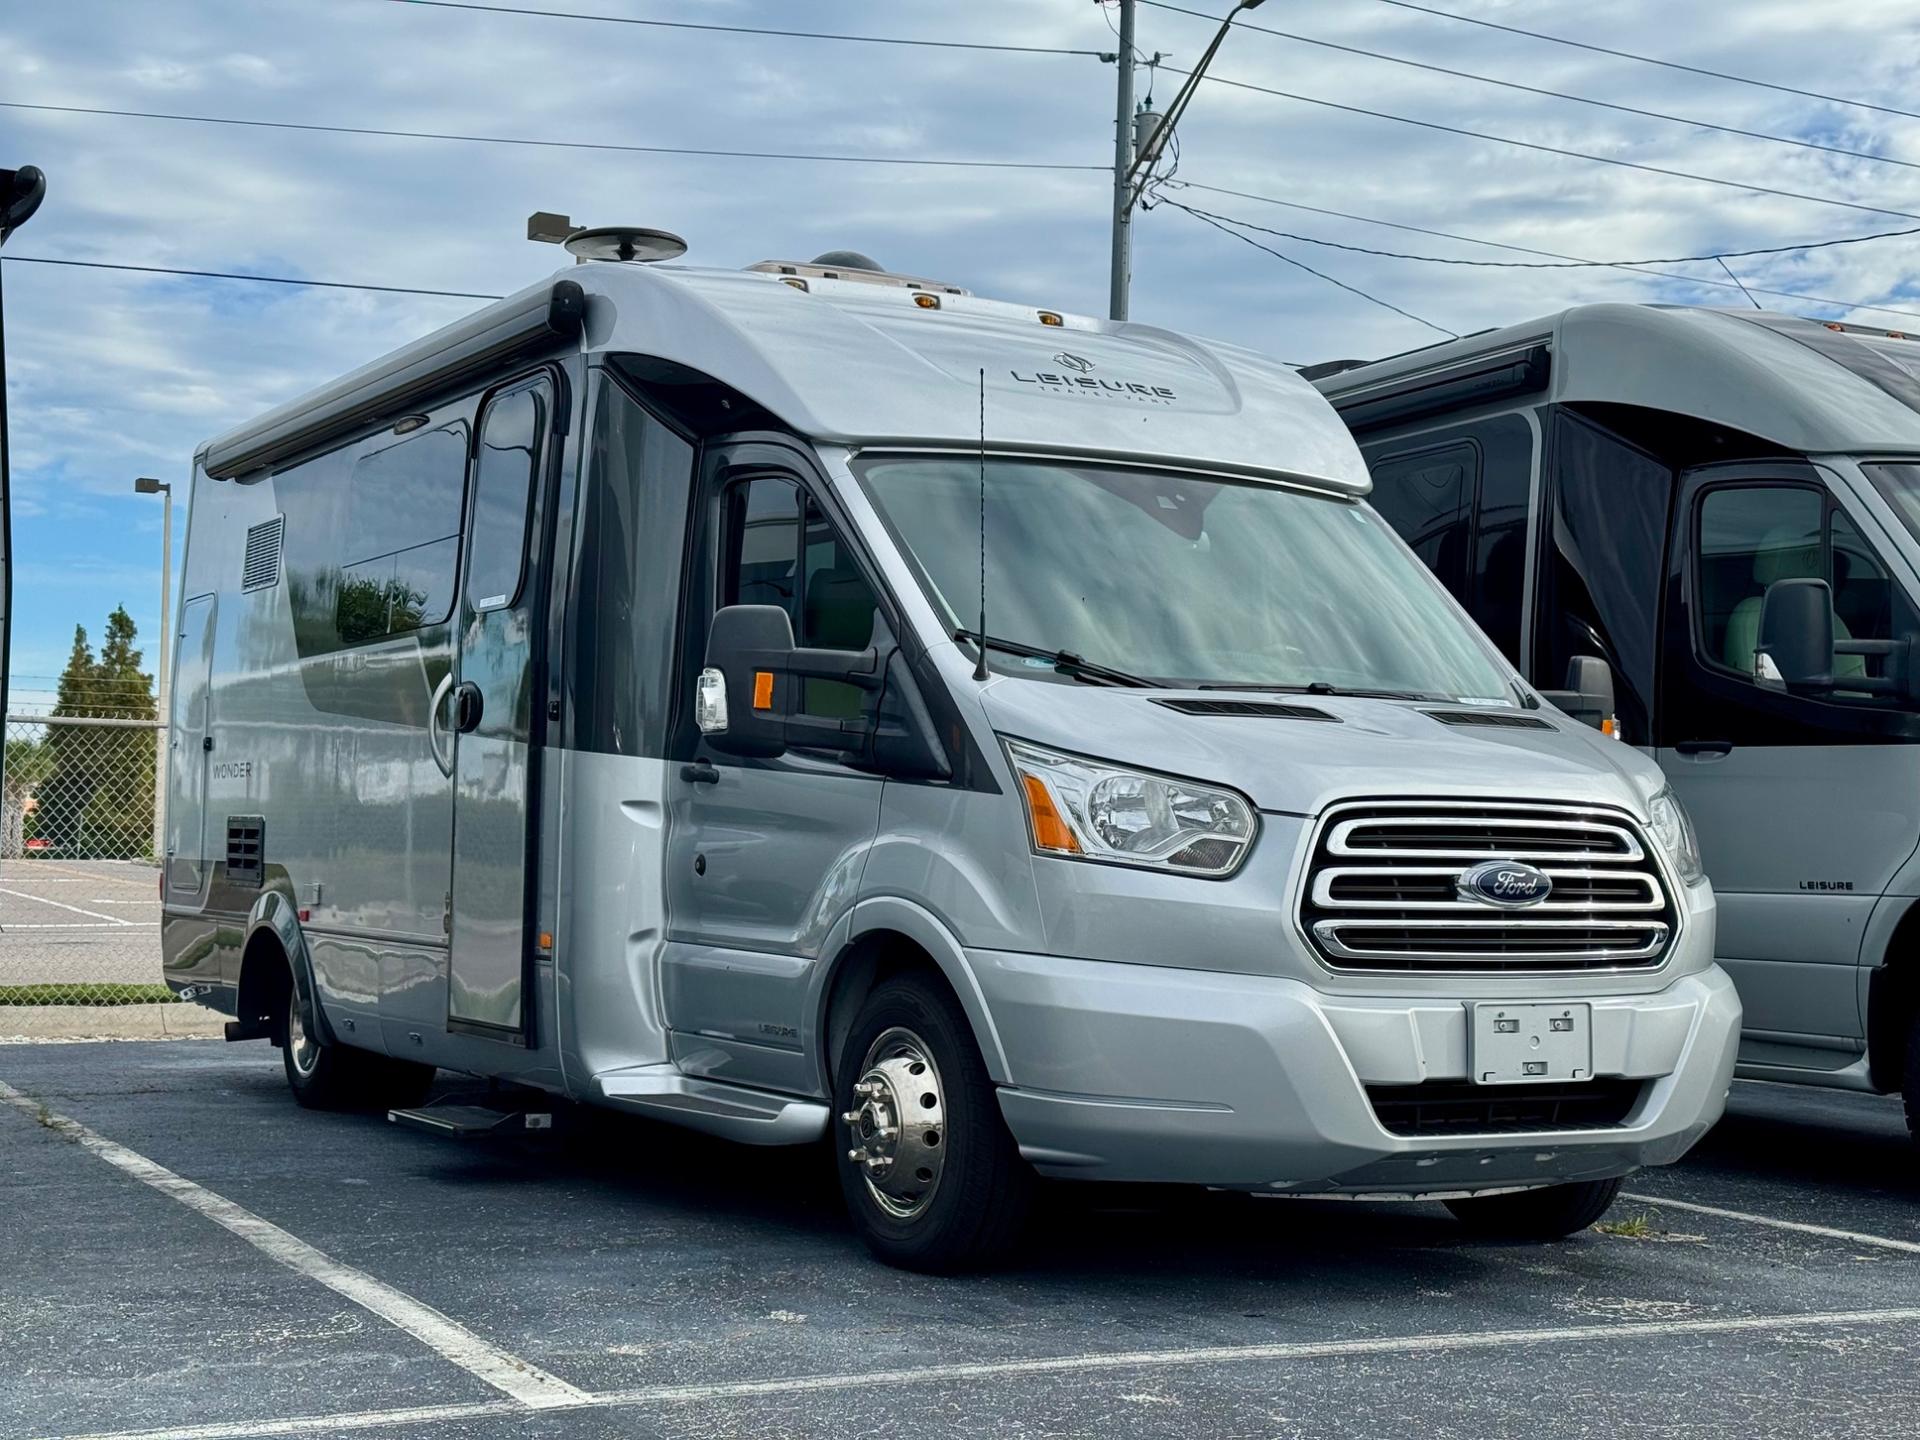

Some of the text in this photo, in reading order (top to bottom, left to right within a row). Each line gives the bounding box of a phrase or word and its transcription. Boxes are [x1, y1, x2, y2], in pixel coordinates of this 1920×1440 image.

[1011, 370, 1176, 400] LEISURE
[213, 762, 251, 779] WONDER
[1493, 871, 1537, 895] Ford
[1799, 881, 1853, 890] LEISURE
[758, 1024, 797, 1038] LEISURE
